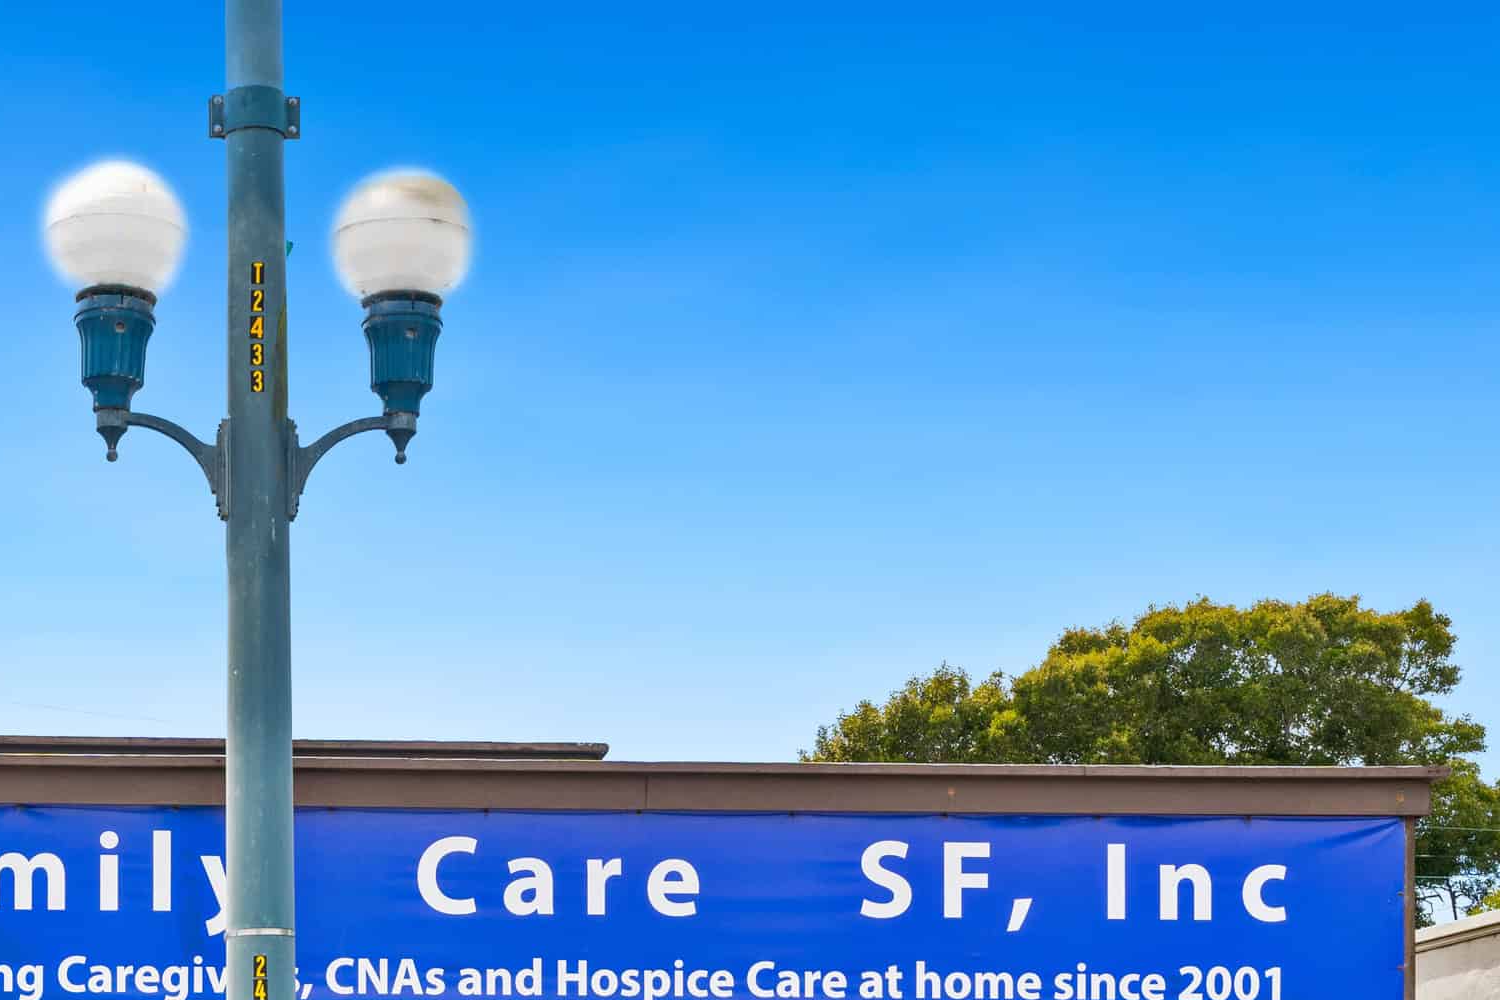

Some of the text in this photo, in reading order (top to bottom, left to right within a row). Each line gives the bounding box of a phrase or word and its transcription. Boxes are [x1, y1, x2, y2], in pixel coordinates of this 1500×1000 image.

[417, 836, 700, 917] Care
[860, 840, 1033, 932] SF,
[1107, 843, 1287, 922] Inc
[325, 958, 445, 996] CNAs
[458, 958, 542, 996] and
[746, 961, 847, 999] Care
[859, 965, 903, 999] at
[916, 961, 1042, 1000] home
[1054, 963, 1166, 1000] since
